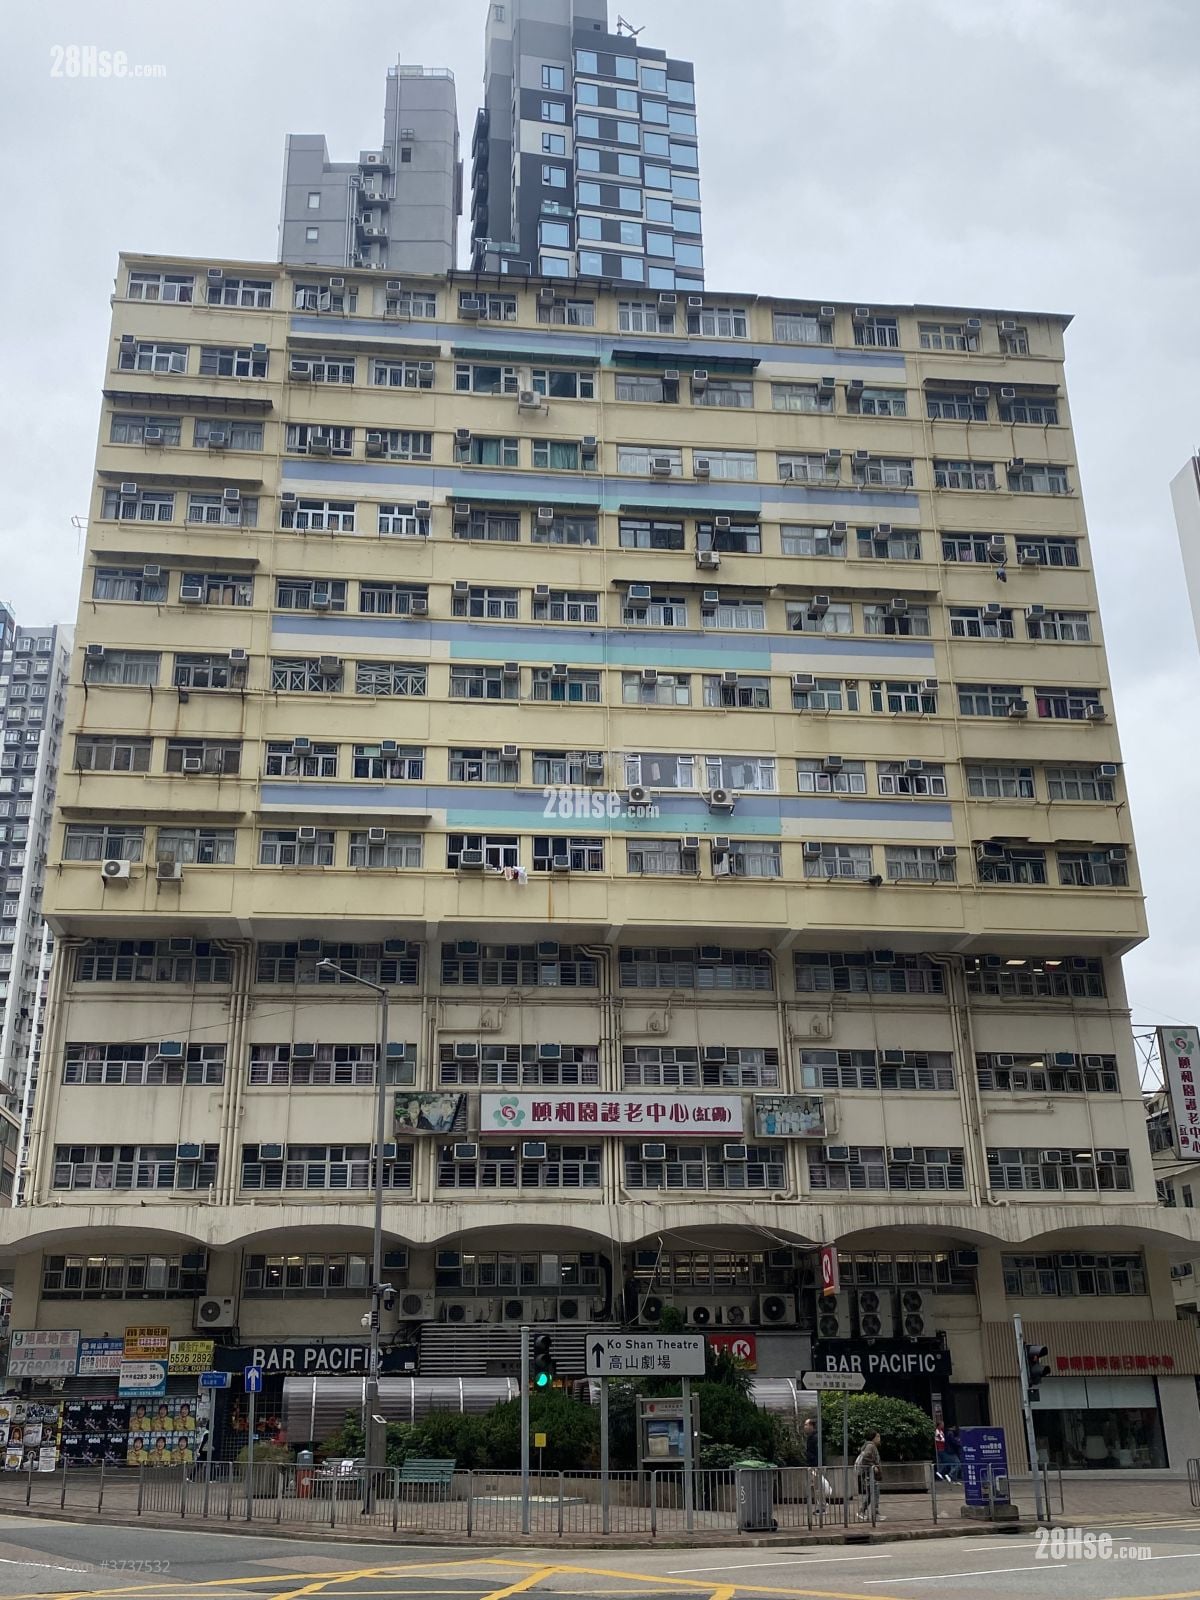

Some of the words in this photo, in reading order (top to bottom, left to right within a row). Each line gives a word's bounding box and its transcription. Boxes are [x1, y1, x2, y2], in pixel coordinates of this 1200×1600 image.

[607, 1339, 622, 1349] Ko
[625, 1339, 653, 1349] Shan
[656, 1339, 699, 1349] Theatre
[170, 1353, 190, 1363] 5526
[192, 1353, 212, 1363] 2892
[252, 1348, 295, 1370] BAR
[609, 1355, 671, 1370] 高山劇場
[826, 1354, 862, 1372] BAR
[868, 1353, 936, 1373] PACIFIC
